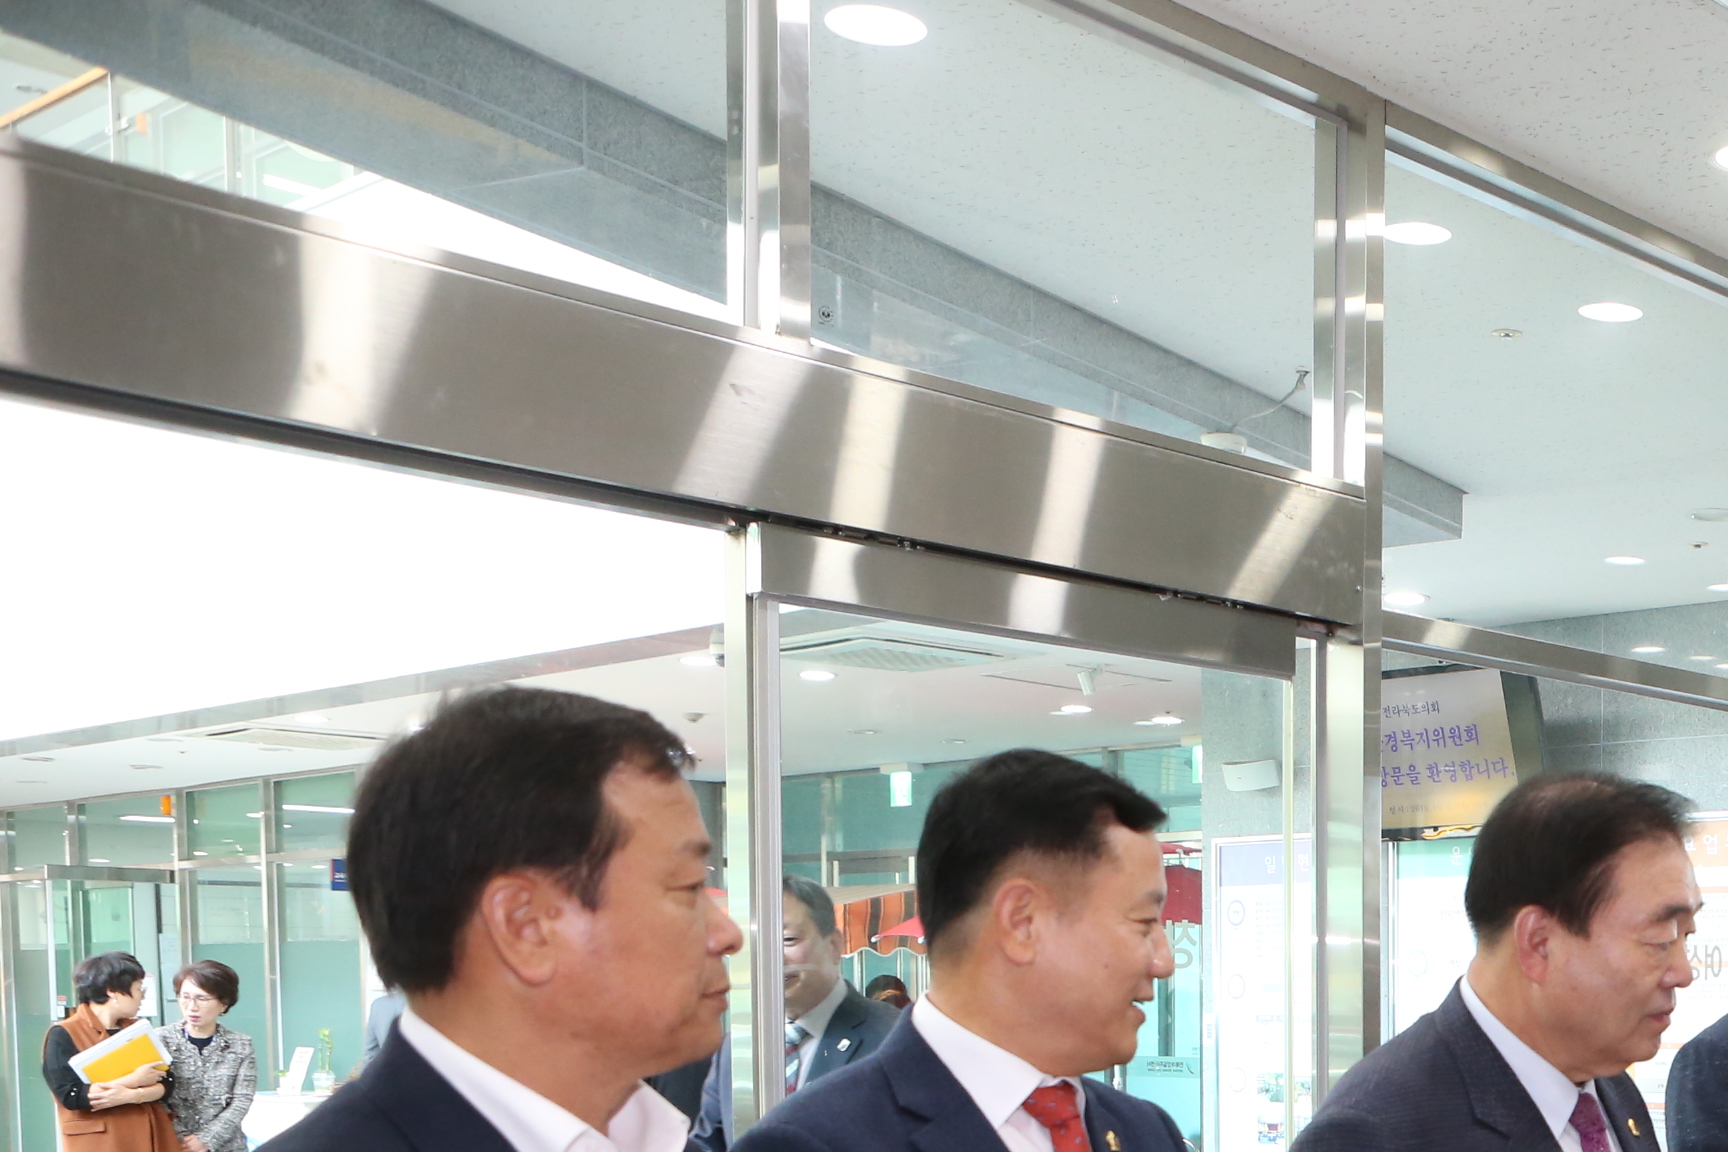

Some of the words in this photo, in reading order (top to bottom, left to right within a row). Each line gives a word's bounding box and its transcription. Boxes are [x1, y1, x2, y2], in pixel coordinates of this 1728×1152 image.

[1382, 700, 1440, 718] 전라북도의회
[1381, 723, 1480, 753] 경복지위원회
[1426, 756, 1516, 784] 환영합니다.
